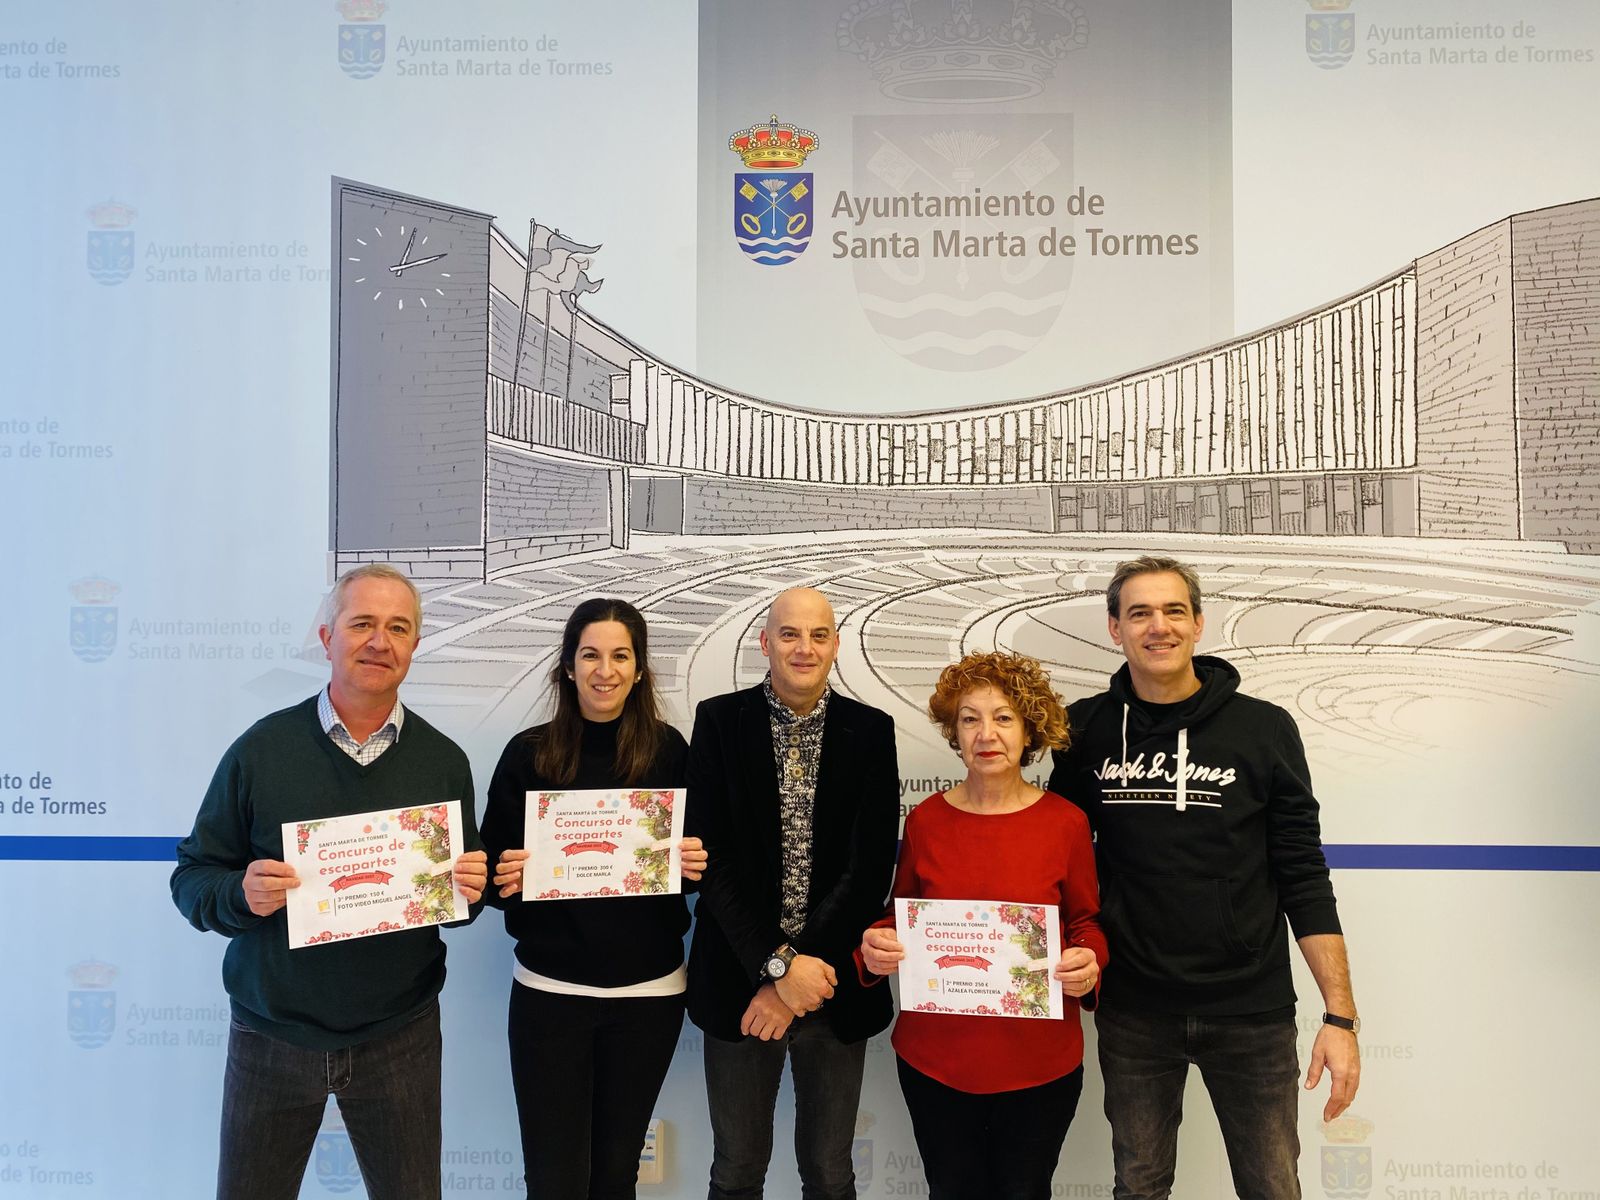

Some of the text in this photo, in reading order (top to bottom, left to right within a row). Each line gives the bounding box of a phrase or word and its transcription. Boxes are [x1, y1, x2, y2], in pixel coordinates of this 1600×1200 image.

[1366, 20, 1537, 45] Ayuntamiento de
[45, 36, 68, 54] de
[396, 33, 560, 56] Ayuntamiento de
[1366, 45, 1595, 65] Santa Marta de Tormes
[28, 61, 50, 78] de
[55, 62, 121, 79] Tormes
[396, 58, 614, 76] Santa Marta de Tormes
[830, 185, 1105, 227] Ayuntamiento de
[144, 239, 309, 262] Ayuntamiento de
[832, 226, 1200, 260] Santa Marta de Tormes
[144, 265, 198, 282] Santa
[205, 264, 262, 282] Marta
[269, 263, 291, 281] de
[36, 416, 59, 434] de
[19, 440, 42, 458] de
[47, 441, 114, 458] Tormes
[128, 616, 292, 640] Ayuntamiento de
[128, 642, 182, 660] Santa
[188, 642, 245, 660] Marta
[251, 641, 274, 660] de
[1147, 752, 1167, 779] &
[29, 770, 53, 790] de
[11, 795, 35, 814] de
[40, 796, 107, 815] Tormes
[1167, 793, 1212, 801] NETY
[554, 815, 633, 828] Concurso de
[554, 830, 623, 841] escapartes
[318, 838, 406, 861] Concurso de
[319, 857, 397, 875] escapartes
[925, 927, 1004, 941] Concurso de
[926, 944, 996, 955] escapartes
[28, 1165, 95, 1185] Tormes
[1384, 1157, 1560, 1182] Ayuntamiento de
